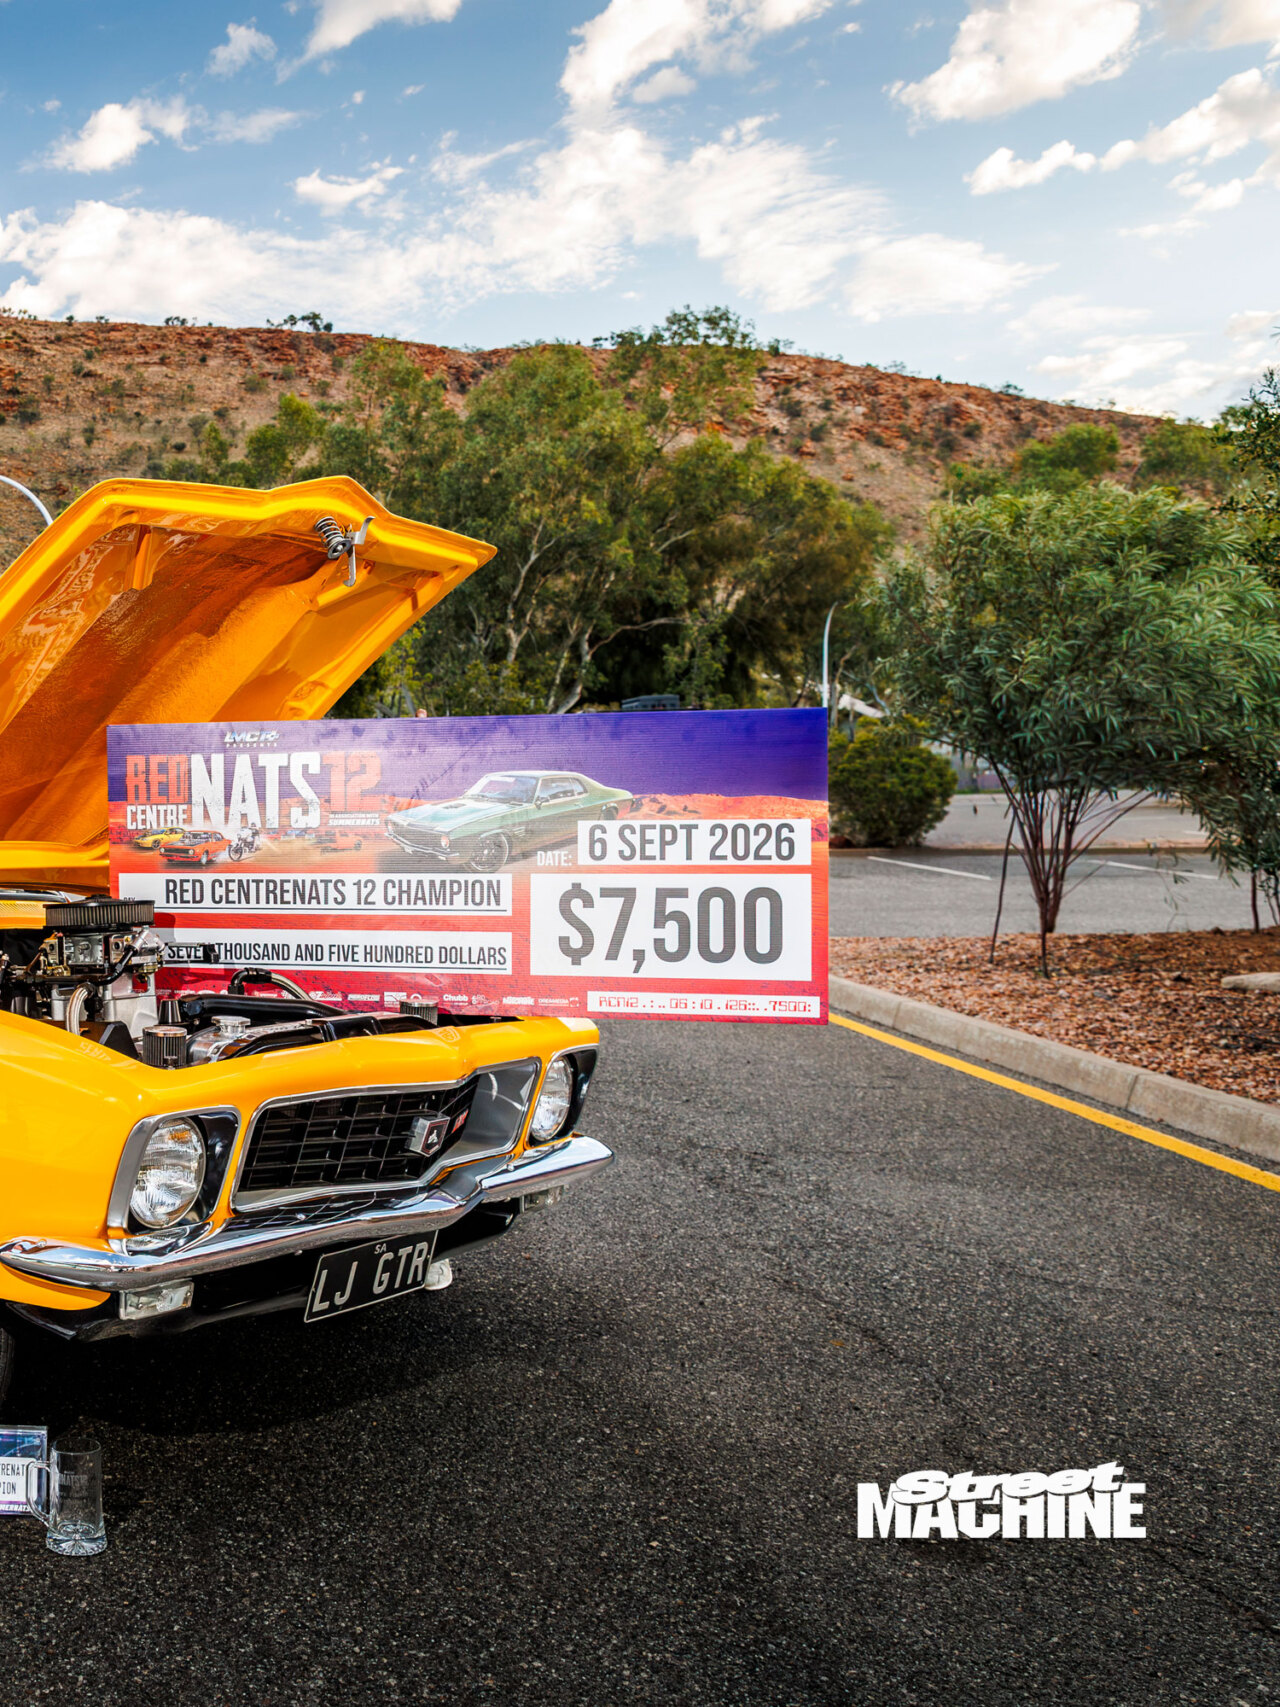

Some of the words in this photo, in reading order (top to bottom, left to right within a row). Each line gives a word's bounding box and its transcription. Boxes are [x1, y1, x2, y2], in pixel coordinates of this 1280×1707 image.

[125, 754, 189, 804] RED
[190, 751, 321, 830] NATS
[322, 750, 382, 811] 12
[127, 804, 188, 830] CENTRE
[537, 850, 572, 866] DATE:
[588, 823, 607, 861] 6
[618, 823, 699, 861] SEPT
[709, 822, 795, 861] 2026
[165, 878, 204, 904] RED
[211, 878, 346, 906] CENTRENATS
[353, 879, 376, 906] 12
[383, 879, 501, 907] CHAMPION
[558, 882, 783, 974] $7,500
[167, 943, 204, 960] SEVE
[215, 943, 290, 961] THOUSAND
[294, 943, 324, 962] AND
[328, 944, 359, 963] FIVE
[364, 945, 434, 965] HUNDRED
[438, 946, 507, 966] DOLLARS
[374, 1243, 387, 1255] SA
[312, 1261, 359, 1313] LJ
[372, 1241, 429, 1295] GTR
